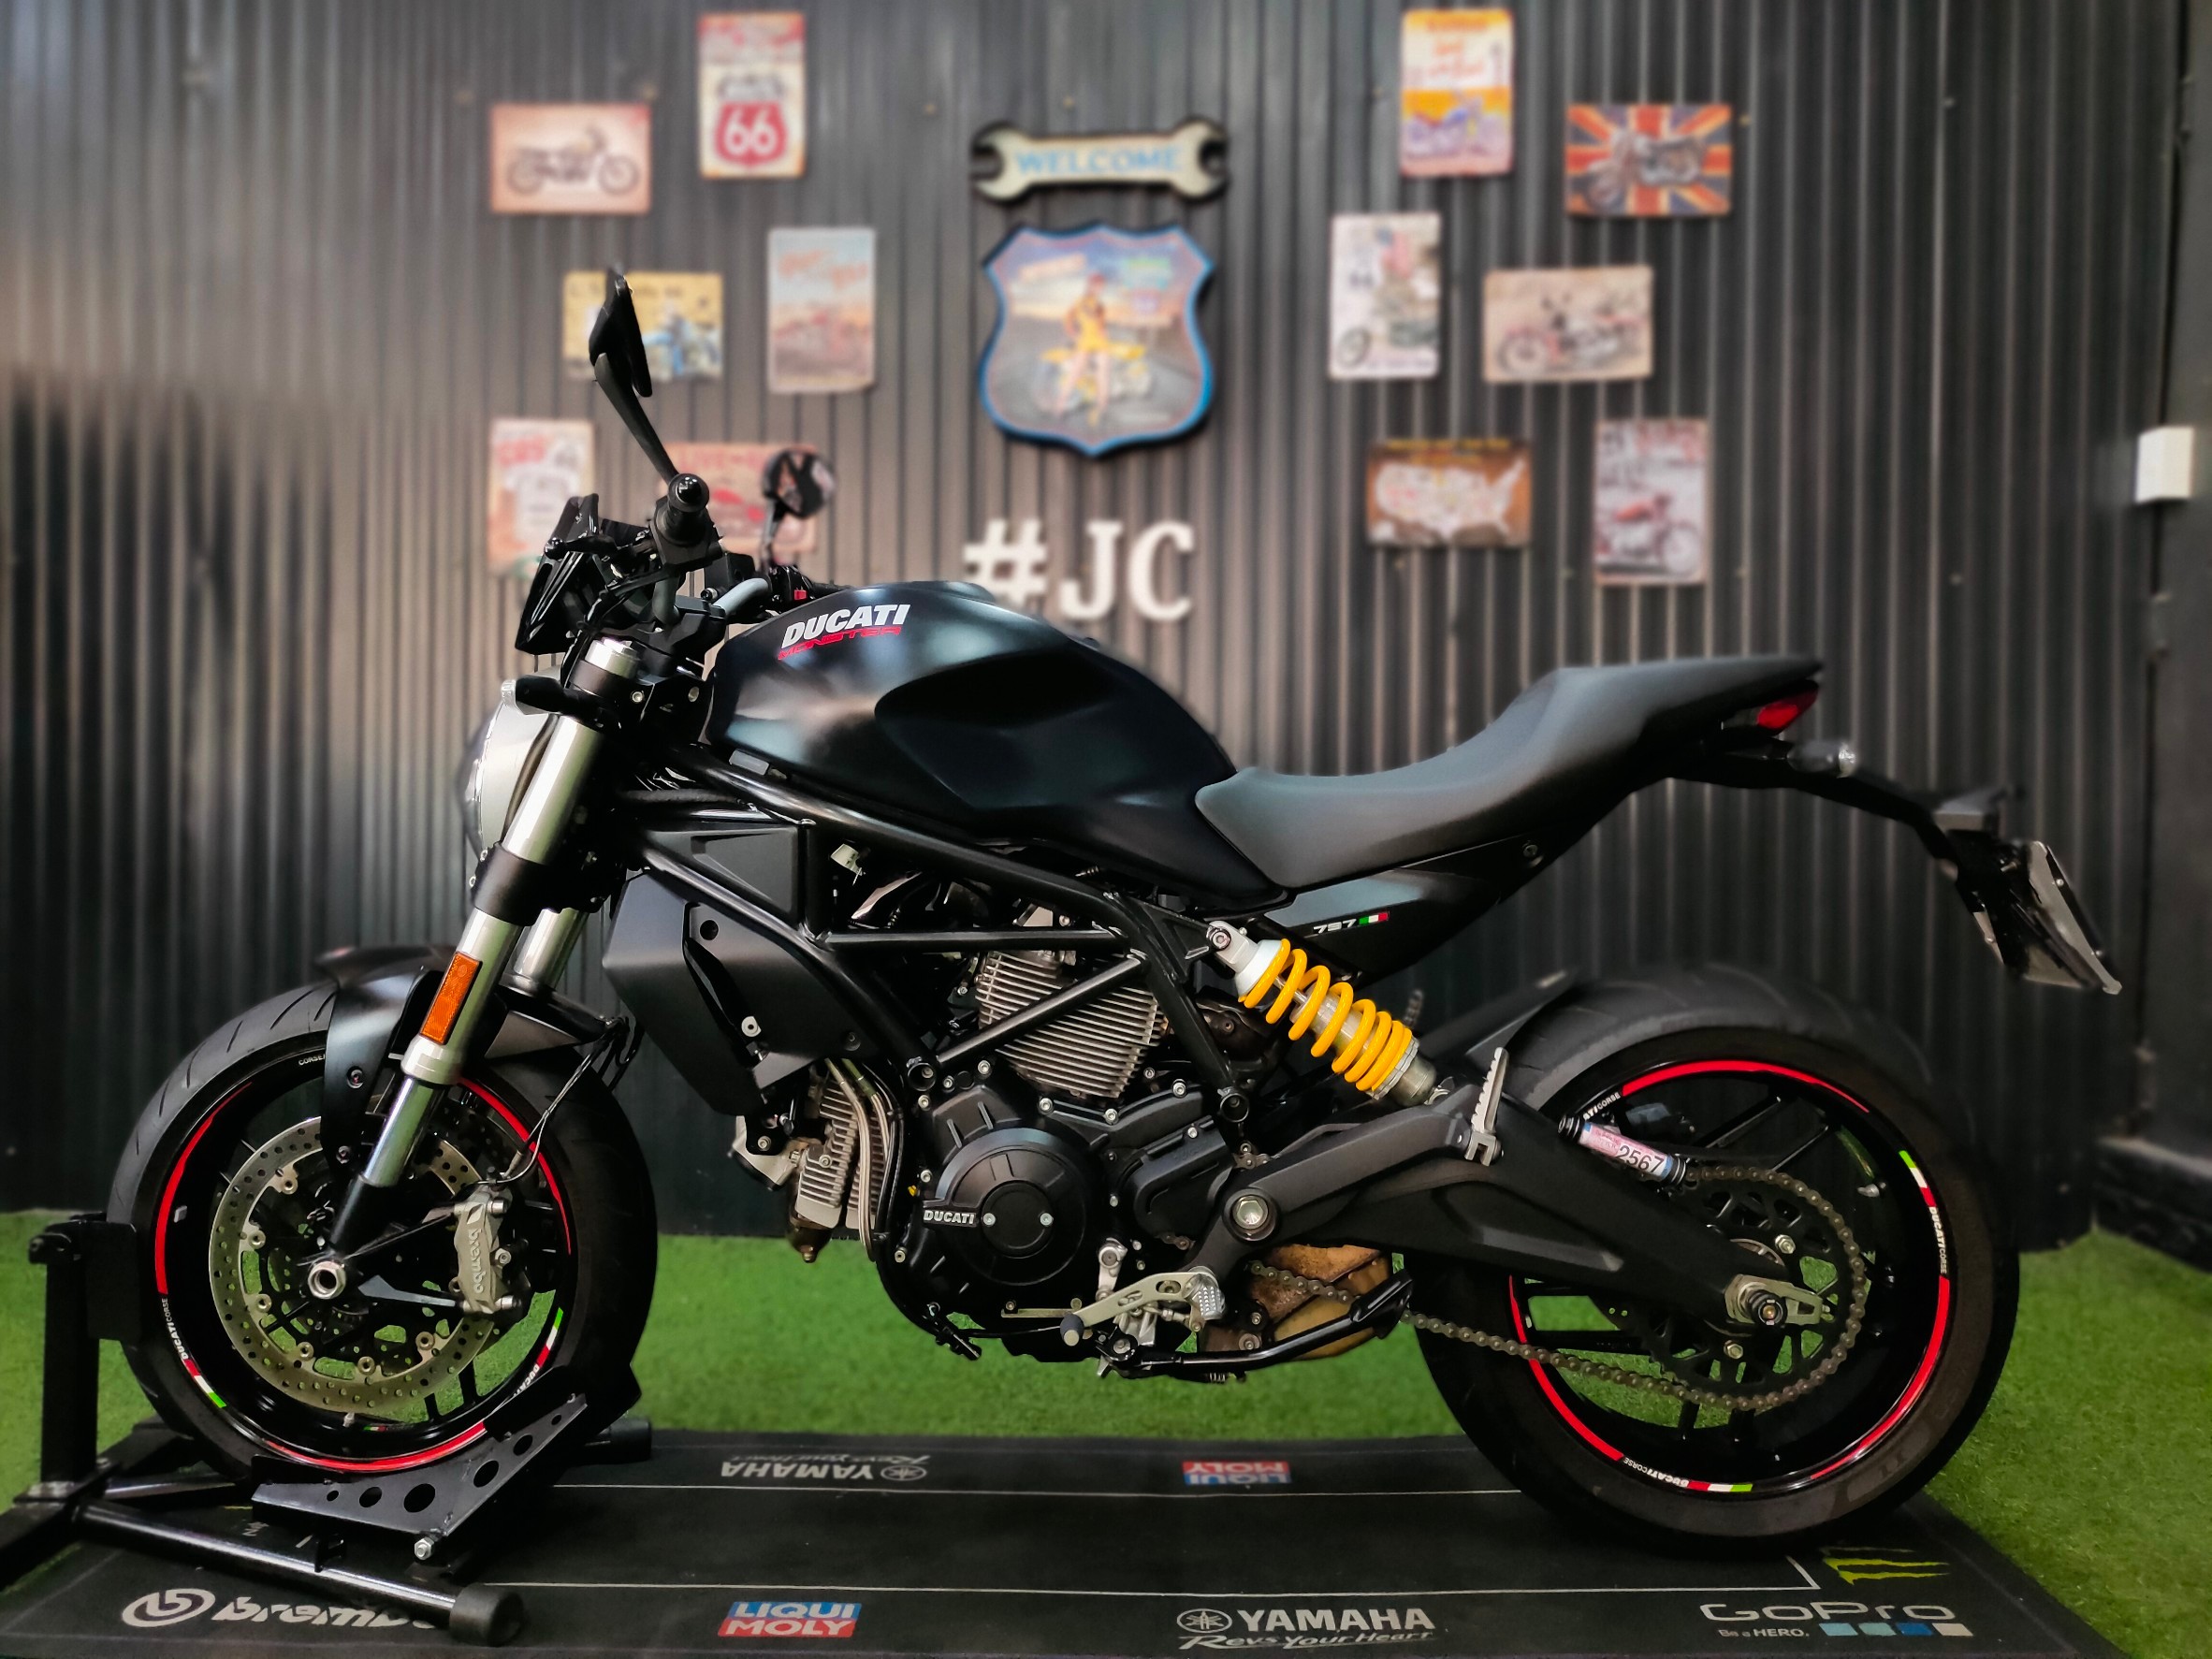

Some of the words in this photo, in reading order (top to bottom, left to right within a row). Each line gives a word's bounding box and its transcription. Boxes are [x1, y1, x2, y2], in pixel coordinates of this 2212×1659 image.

[724, 105, 778, 155] 66
[1014, 145, 1183, 175] WELCOME
[963, 518, 1194, 620] #JC
[781, 604, 910, 648] DUCATI
[778, 626, 902, 661] MONSTER
[1313, 918, 1357, 934] 797
[1597, 1091, 1622, 1110] CORSE
[1616, 1144, 1665, 1173] 2567
[923, 1210, 975, 1225] DUCATI
[1928, 1206, 1946, 1248] DUCATI
[468, 1229, 487, 1294] brembo
[161, 1297, 173, 1322] CORSE
[167, 1321, 189, 1360] DUCATI
[720, 1462, 874, 1479] YAMAHA
[1185, 1462, 1285, 1474] MOLY
[1623, 1457, 1648, 1474] CORSE
[1646, 1468, 1690, 1489] DUCATI
[735, 1603, 855, 1619] LIQUI
[1237, 1608, 1436, 1632] YAMAHA
[1699, 1601, 1957, 1622] GoPro
[725, 1620, 850, 1636] MOLY
